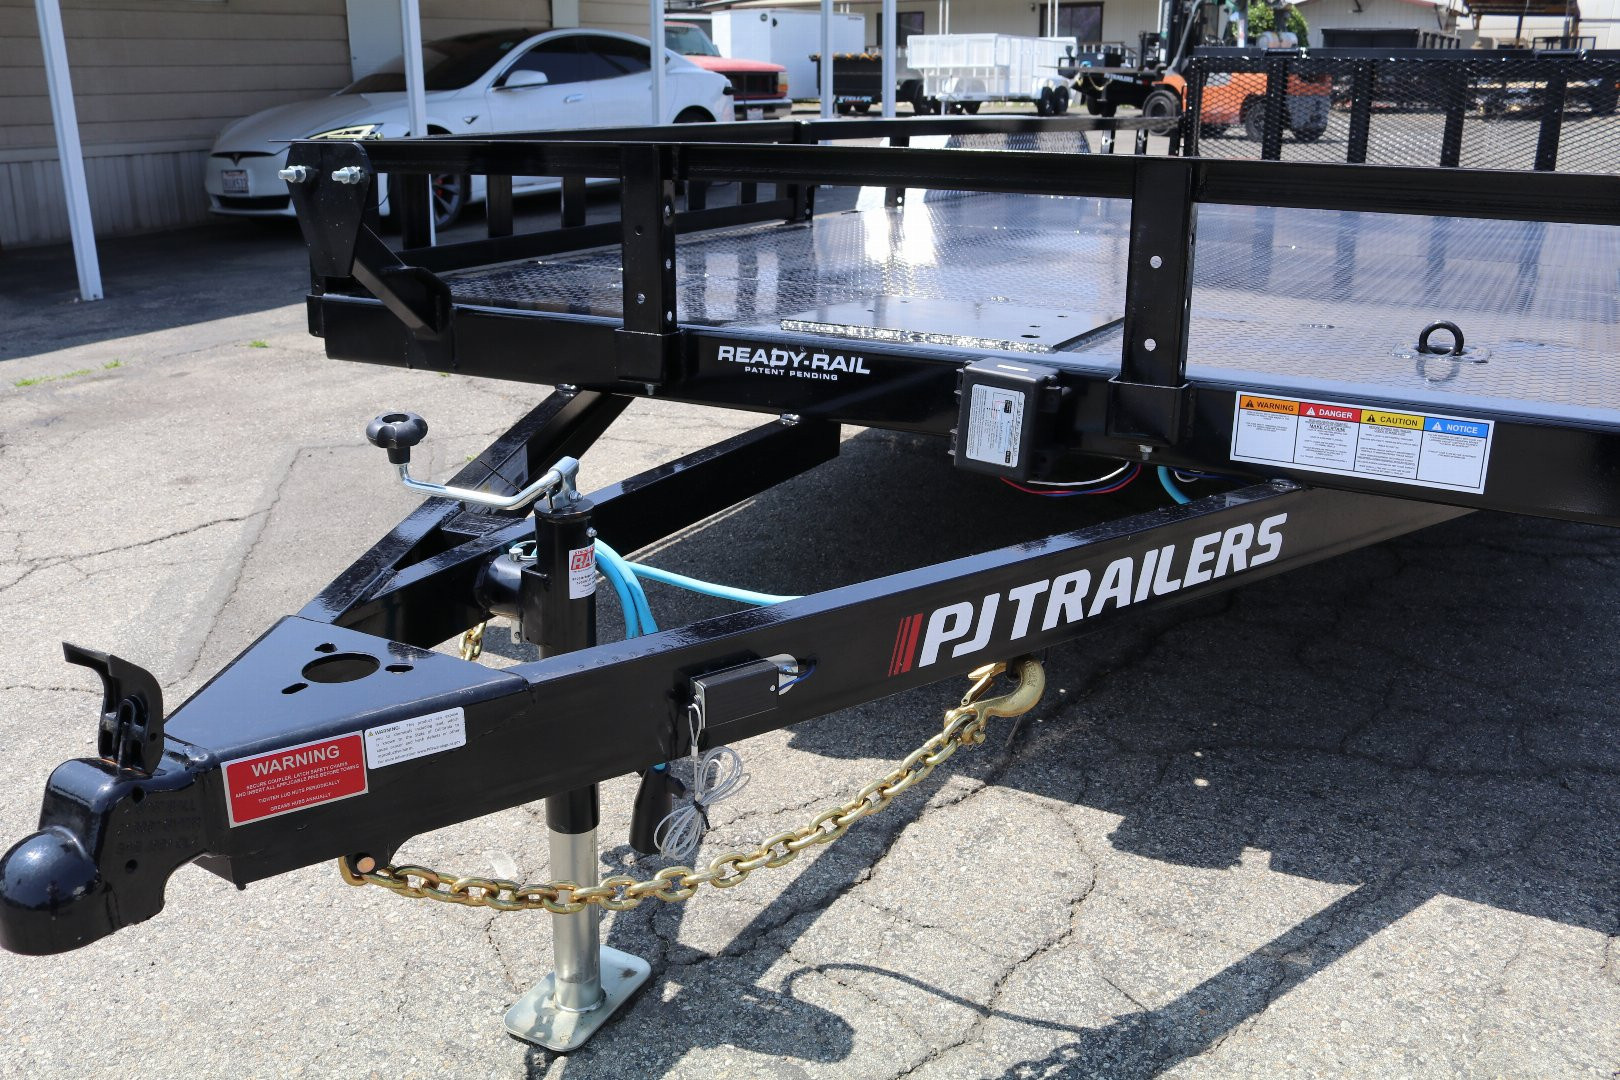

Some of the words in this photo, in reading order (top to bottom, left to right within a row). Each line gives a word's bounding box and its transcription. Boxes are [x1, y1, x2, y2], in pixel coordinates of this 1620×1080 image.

[717, 345, 871, 375] READY-RAIL
[744, 366, 785, 376] PATENT
[789, 370, 838, 381] PENDING
[1256, 401, 1294, 412] WARNING
[1319, 408, 1353, 419] DANGER
[1380, 415, 1418, 427] CAUTION
[1446, 424, 1479, 434] NOTICE
[918, 592, 1001, 668] PJ
[1008, 512, 1288, 641] TRAILERS
[250, 744, 340, 777] WARNING
[246, 780, 267, 790] SECURE
[293, 770, 310, 778] LATCH
[310, 765, 328, 774] SAFETY
[235, 790, 247, 798] AND
[247, 785, 266, 795] INSERT
